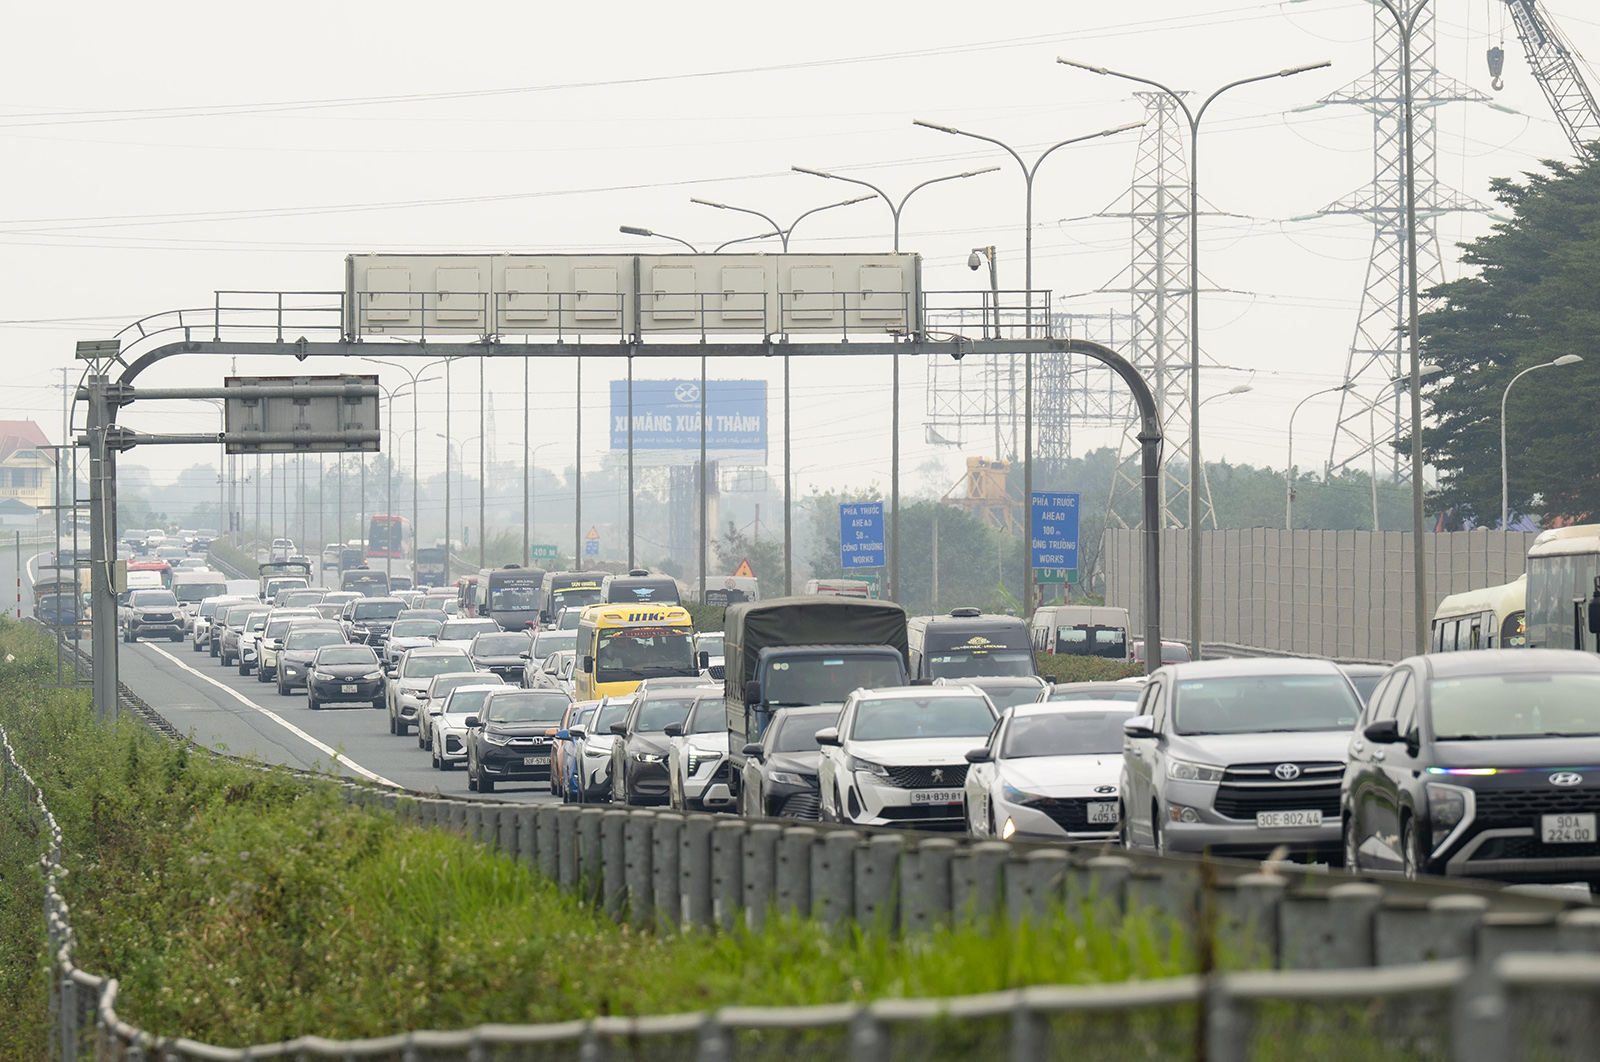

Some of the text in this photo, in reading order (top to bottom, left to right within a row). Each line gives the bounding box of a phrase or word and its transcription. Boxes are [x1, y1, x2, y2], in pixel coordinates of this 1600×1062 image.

[632, 411, 672, 432] MĂNG
[1032, 494, 1049, 507] PHÍA
[1041, 511, 1065, 521] AHEAD
[852, 519, 873, 527] AHEAD
[855, 530, 864, 540] 50
[1042, 525, 1055, 535] 100
[1032, 537, 1047, 549] ÔNG
[852, 555, 874, 564] WORKS
[1039, 554, 1064, 564] WORKS
[915, 792, 961, 802] 99A-839.81
[1098, 803, 1115, 812] 37K
[1259, 812, 1320, 826] 30E-802.44
[1556, 815, 1580, 828] 90A
[1548, 828, 1590, 841] 224.00
